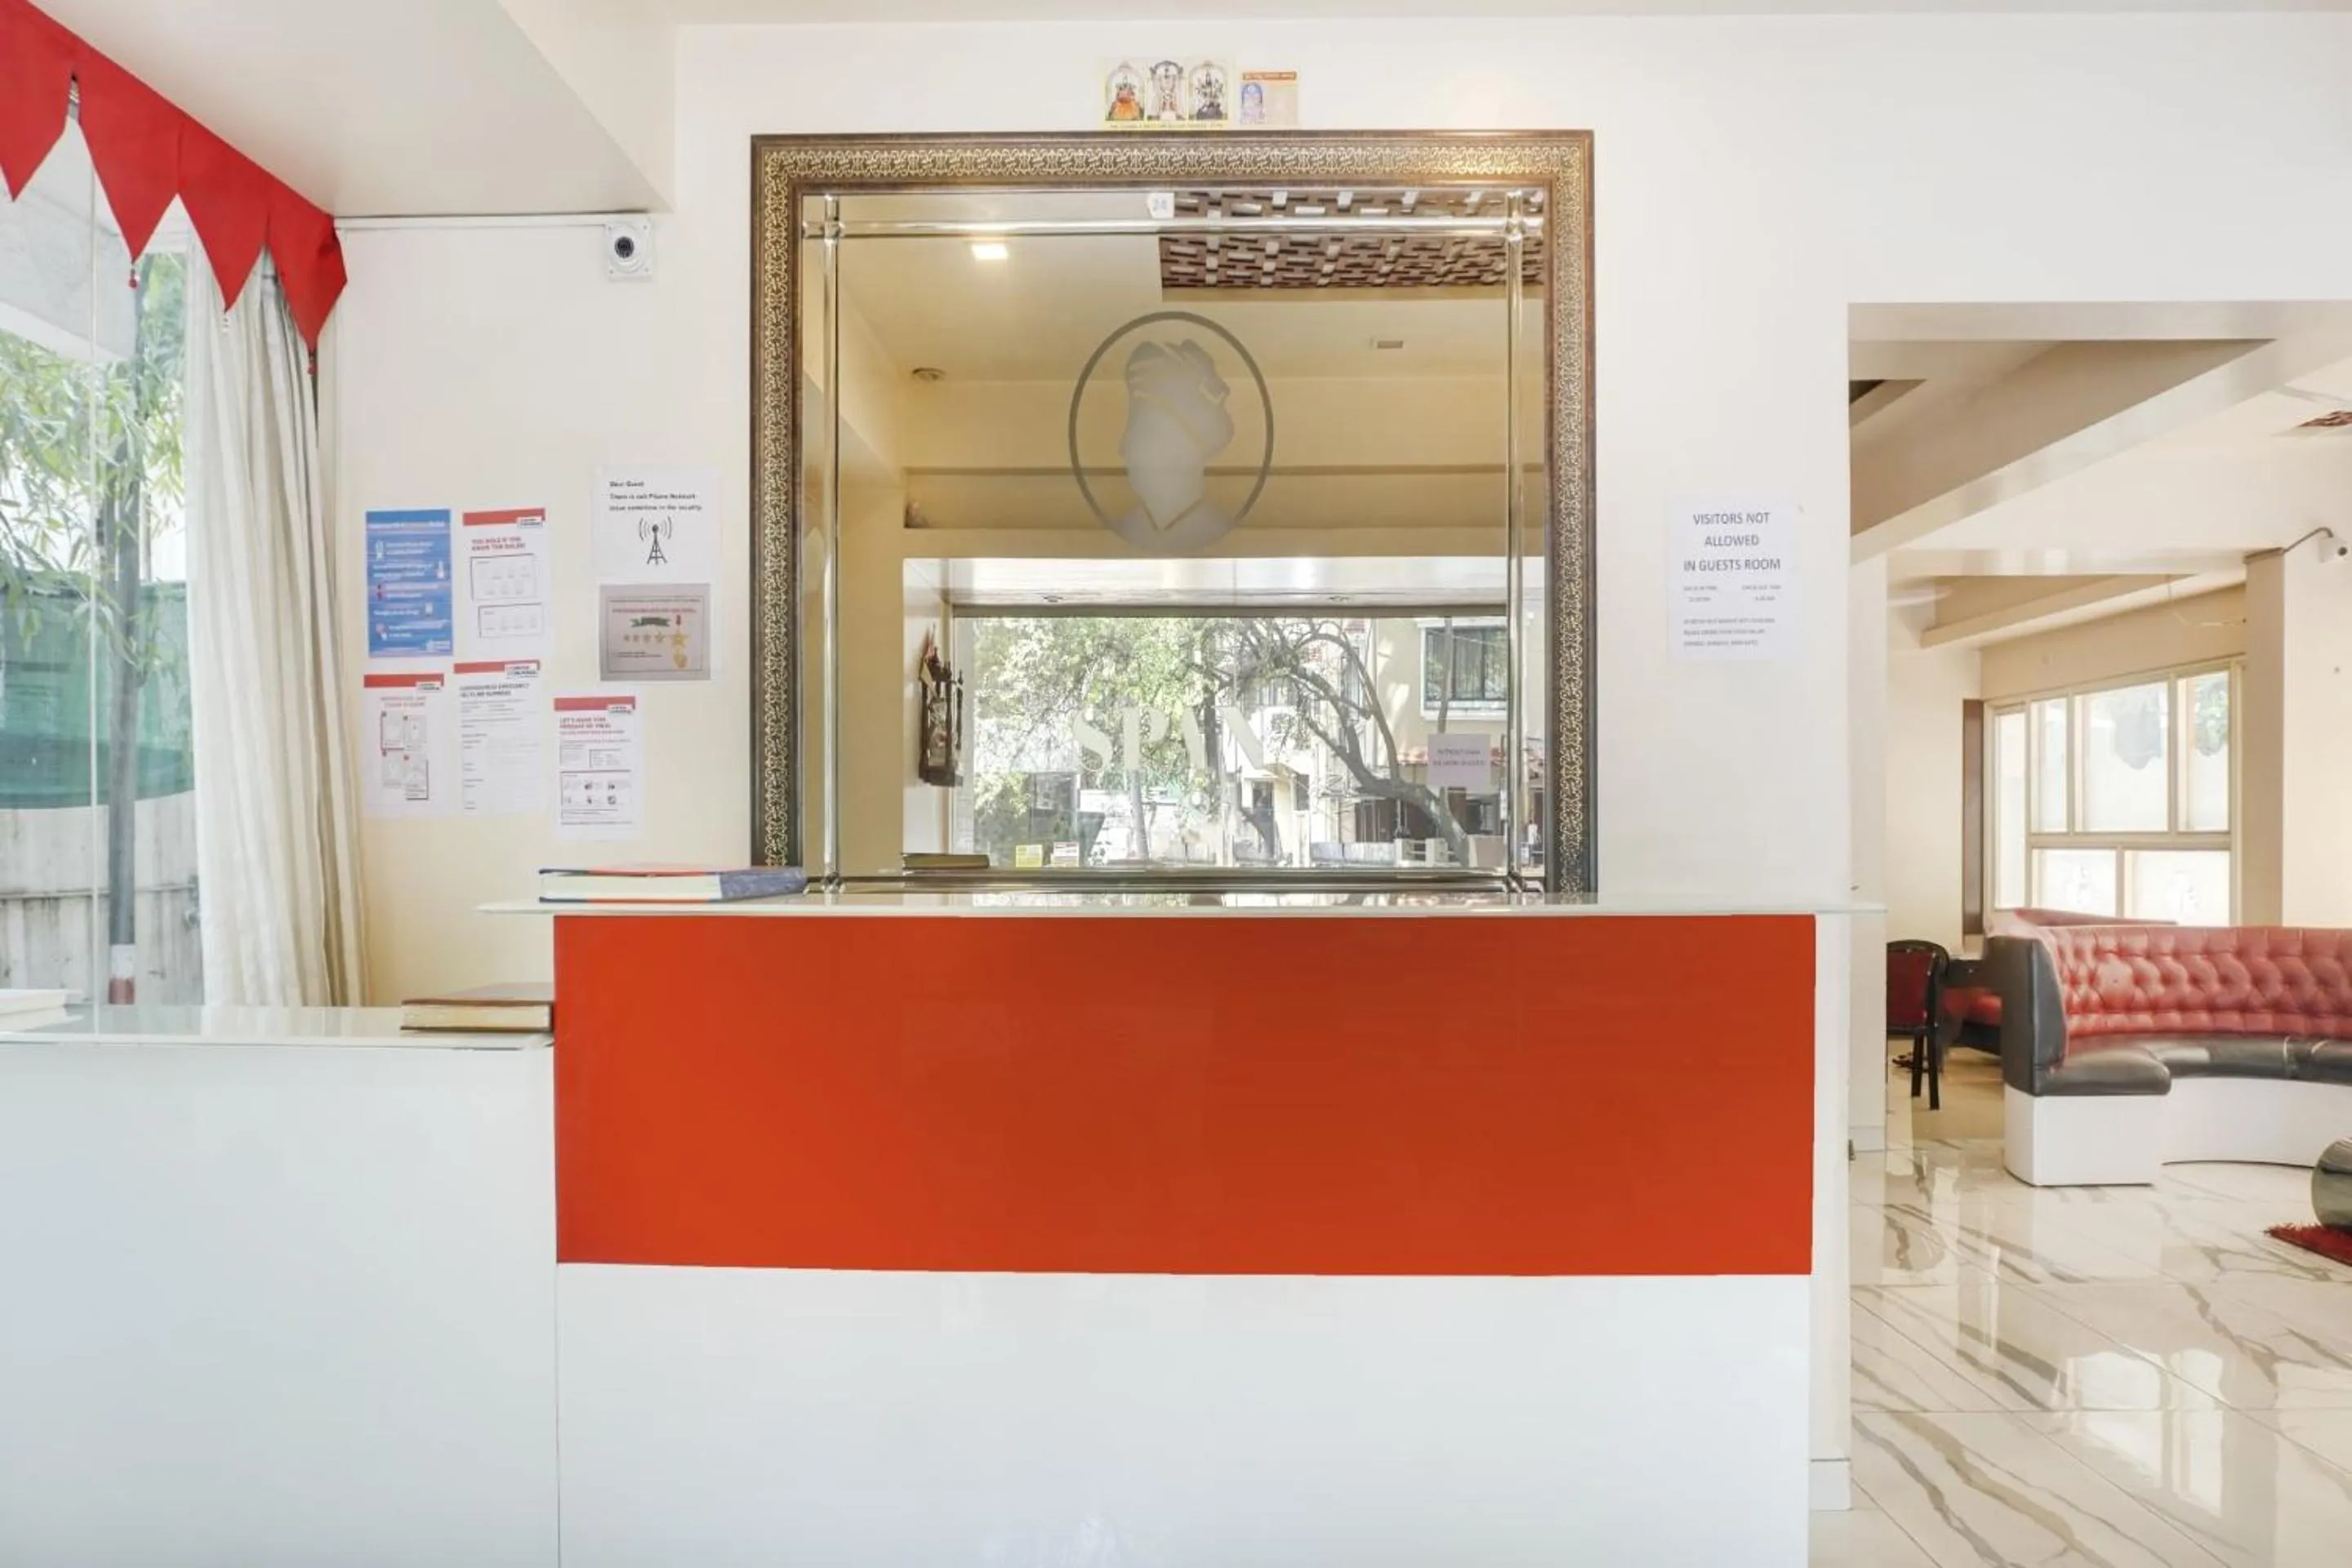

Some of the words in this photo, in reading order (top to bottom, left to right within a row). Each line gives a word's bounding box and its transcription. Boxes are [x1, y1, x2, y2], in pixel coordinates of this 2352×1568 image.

[1693, 513, 1743, 525] VISITORS
[1746, 512, 1771, 524] NOT
[1704, 534, 1760, 547] ALLOWED
[1683, 559, 1696, 572] IN
[1699, 559, 1741, 572] GUESTS
[1744, 558, 1781, 571] ROOM
